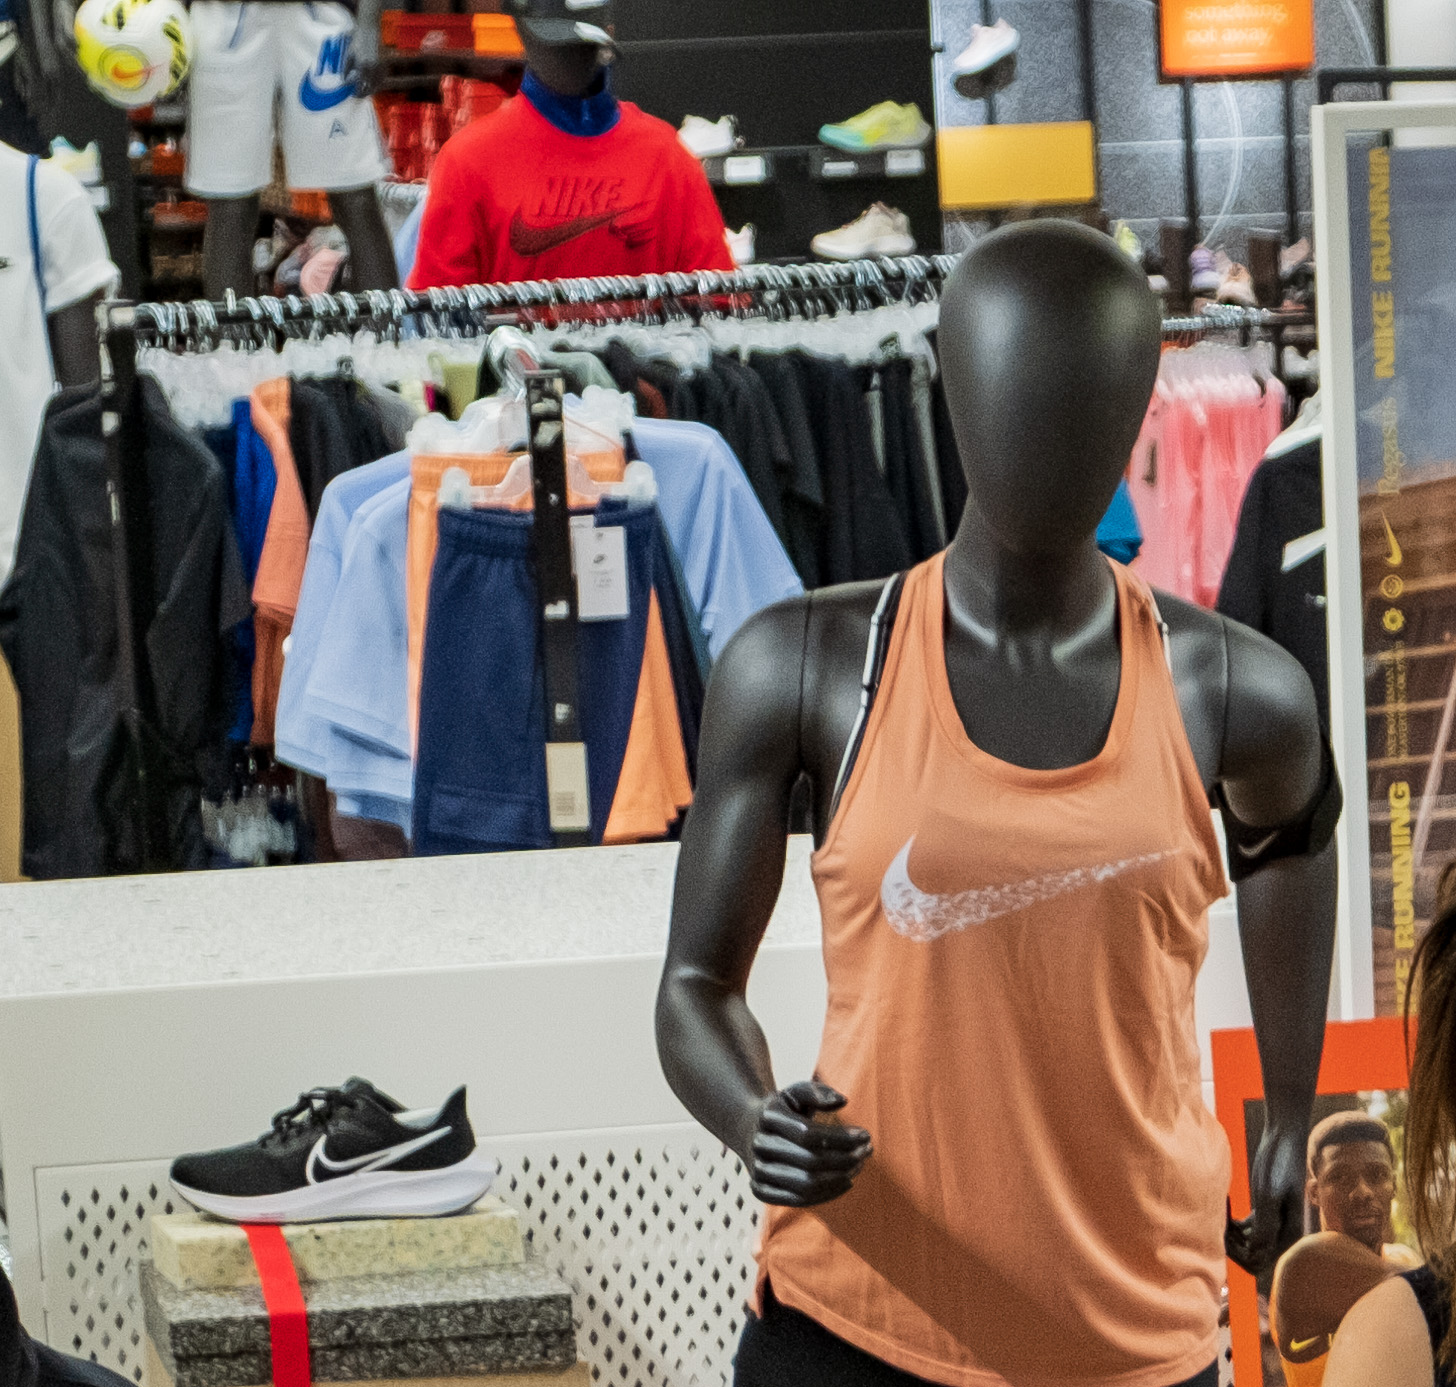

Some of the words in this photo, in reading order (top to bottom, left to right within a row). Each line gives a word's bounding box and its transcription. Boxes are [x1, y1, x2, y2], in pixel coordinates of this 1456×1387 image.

[533, 174, 627, 218] NIKE
[1369, 147, 1392, 283] RUNNIN
[1372, 291, 1395, 379] NIKE
[1389, 780, 1415, 950] RUNNING
